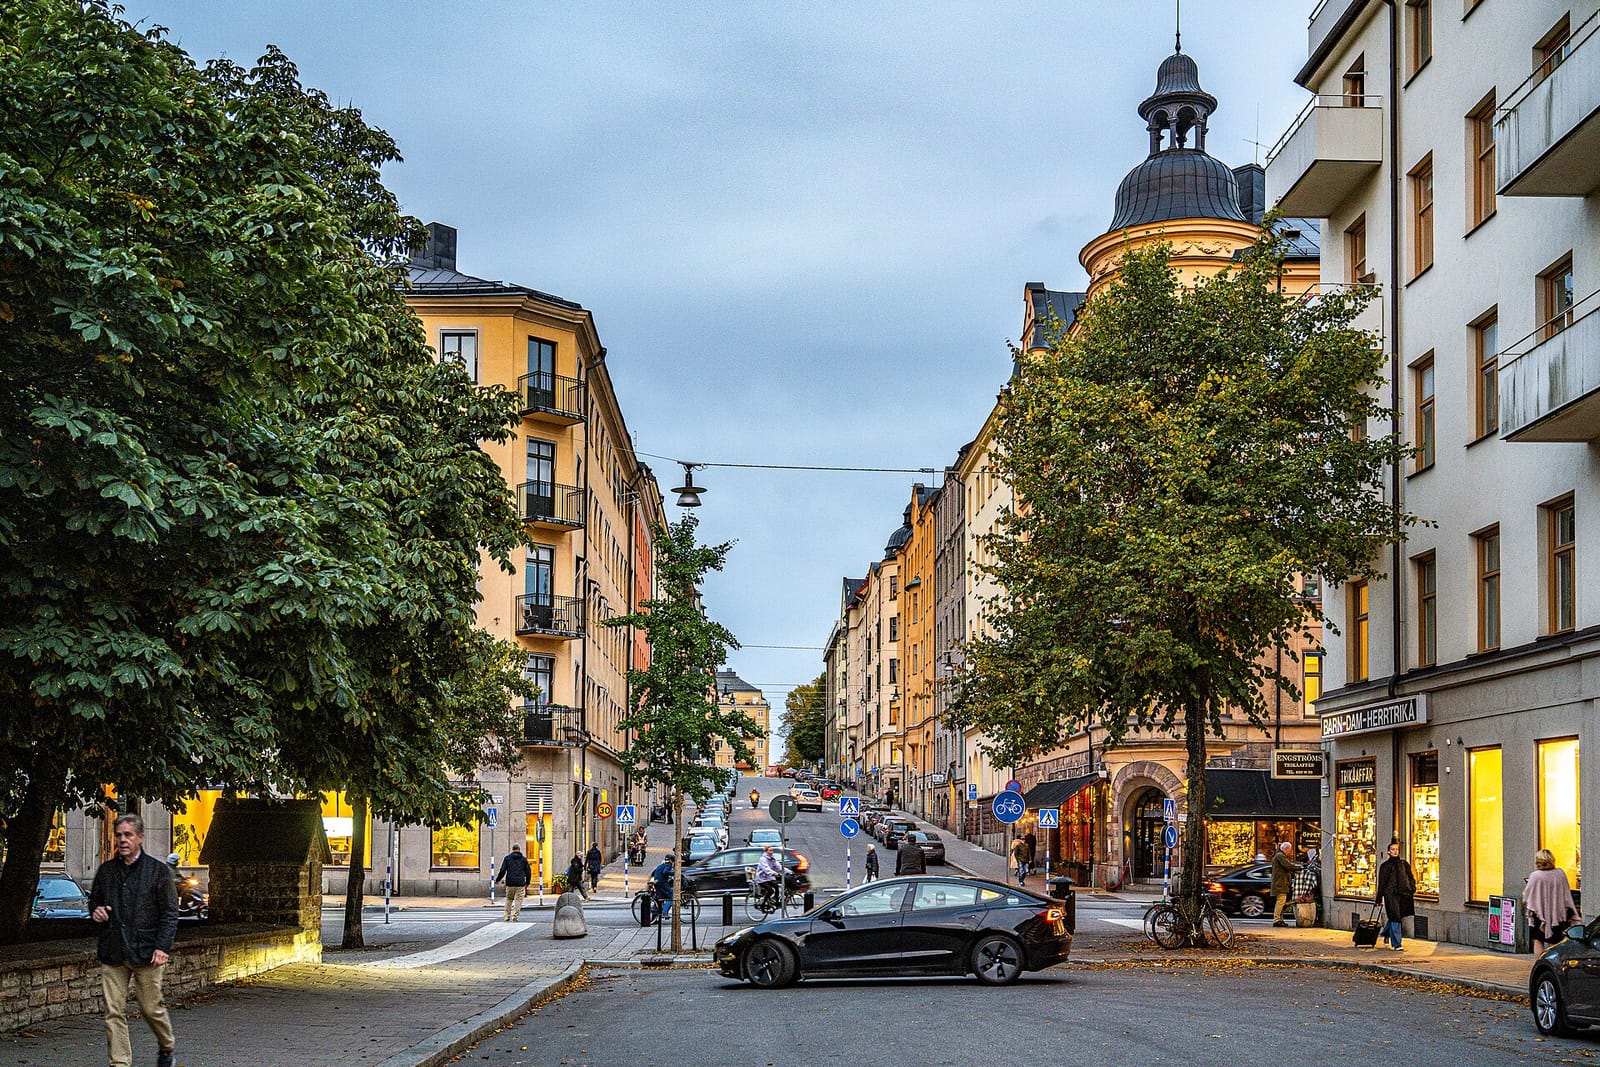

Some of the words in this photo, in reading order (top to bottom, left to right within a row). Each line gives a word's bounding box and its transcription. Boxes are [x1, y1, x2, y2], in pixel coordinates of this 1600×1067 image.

[1277, 754, 1322, 762] ENGSTRÖMS
[1340, 766, 1374, 784] TRIKÅAFFÄR
[600, 806, 610, 814] 30
